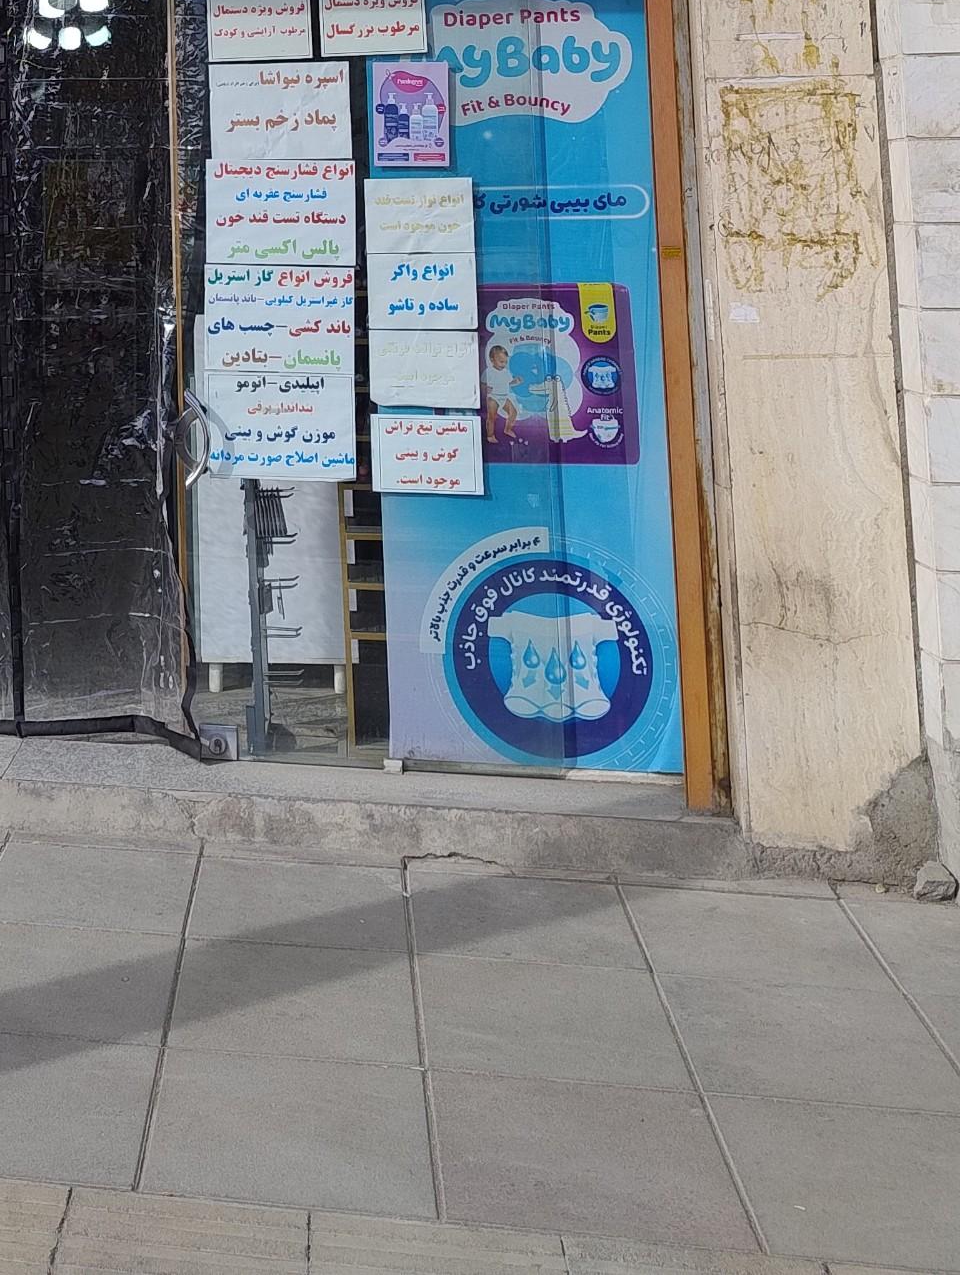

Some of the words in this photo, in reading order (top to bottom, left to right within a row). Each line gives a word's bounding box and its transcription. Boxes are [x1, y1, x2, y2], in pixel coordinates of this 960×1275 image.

[213, 5, 248, 17] دستمال
[251, 5, 273, 16] ویژه
[276, 0, 305, 15] فروش
[444, 11, 513, 29] Diaper
[520, 8, 581, 24] Pants
[214, 28, 238, 38] کودک
[241, 30, 245, 38] و
[247, 26, 276, 37] آرایشی
[280, 26, 306, 36] مرطوب
[327, 23, 374, 38] بزرگسال
[378, 21, 420, 36] مرطوب
[260, 69, 300, 89] نیواشا
[305, 69, 344, 89] اسپره
[461, 100, 484, 117] Fit
[487, 96, 501, 109] &
[503, 93, 571, 116] Bouncy
[225, 113, 260, 133] بستر
[265, 109, 299, 132] زخم
[304, 109, 336, 132] پماد
[214, 163, 262, 179] دیجیتال
[322, 163, 353, 180] انواع
[236, 188, 250, 202] ای
[253, 189, 280, 201] عقربه
[593, 192, 627, 211] مای
[490, 193, 547, 215] شورتی
[550, 197, 590, 214] بیبی
[216, 211, 244, 227] خون
[248, 210, 269, 224] قند
[273, 211, 300, 224] تست
[304, 210, 346, 224] دستگاه
[227, 241, 250, 259] متر
[255, 239, 297, 260] اکسی
[302, 239, 339, 261] پالس
[208, 269, 249, 286] استریل
[254, 268, 273, 286] گاز
[277, 270, 310, 287] انواع
[313, 270, 353, 288] فروش
[391, 263, 418, 281] واکر
[422, 264, 454, 281] انواع
[388, 298, 415, 315] تاشو
[418, 303, 424, 315] و
[428, 297, 459, 311] ساده
[587, 407, 623, 415] Anatomic
[224, 426, 251, 441] بینی
[256, 430, 263, 442] و
[266, 425, 298, 442] گوش
[302, 428, 336, 444] موزن
[385, 420, 413, 436] تراش
[416, 424, 433, 436] تیغ
[436, 421, 468, 436] ماشین
[209, 449, 245, 465] مردانه
[247, 452, 282, 466] صورت
[285, 451, 318, 466] اصلاح
[321, 453, 355, 468] ماشین
[395, 450, 419, 461] بینی
[422, 452, 428, 462] و
[432, 448, 459, 463] گوش
[426, 476, 460, 489] موجود
[508, 538, 531, 553] برابر
[475, 545, 507, 565] سرعت
[468, 562, 477, 571] و
[447, 566, 469, 591] قدرت
[500, 567, 536, 596] کانال
[540, 568, 612, 601] قدرتمند
[438, 591, 453, 615] جذب
[471, 585, 498, 622] فوق
[429, 615, 445, 642] بالاتر
[606, 601, 648, 675] تکنولوژی
[459, 623, 483, 670] جاذب
